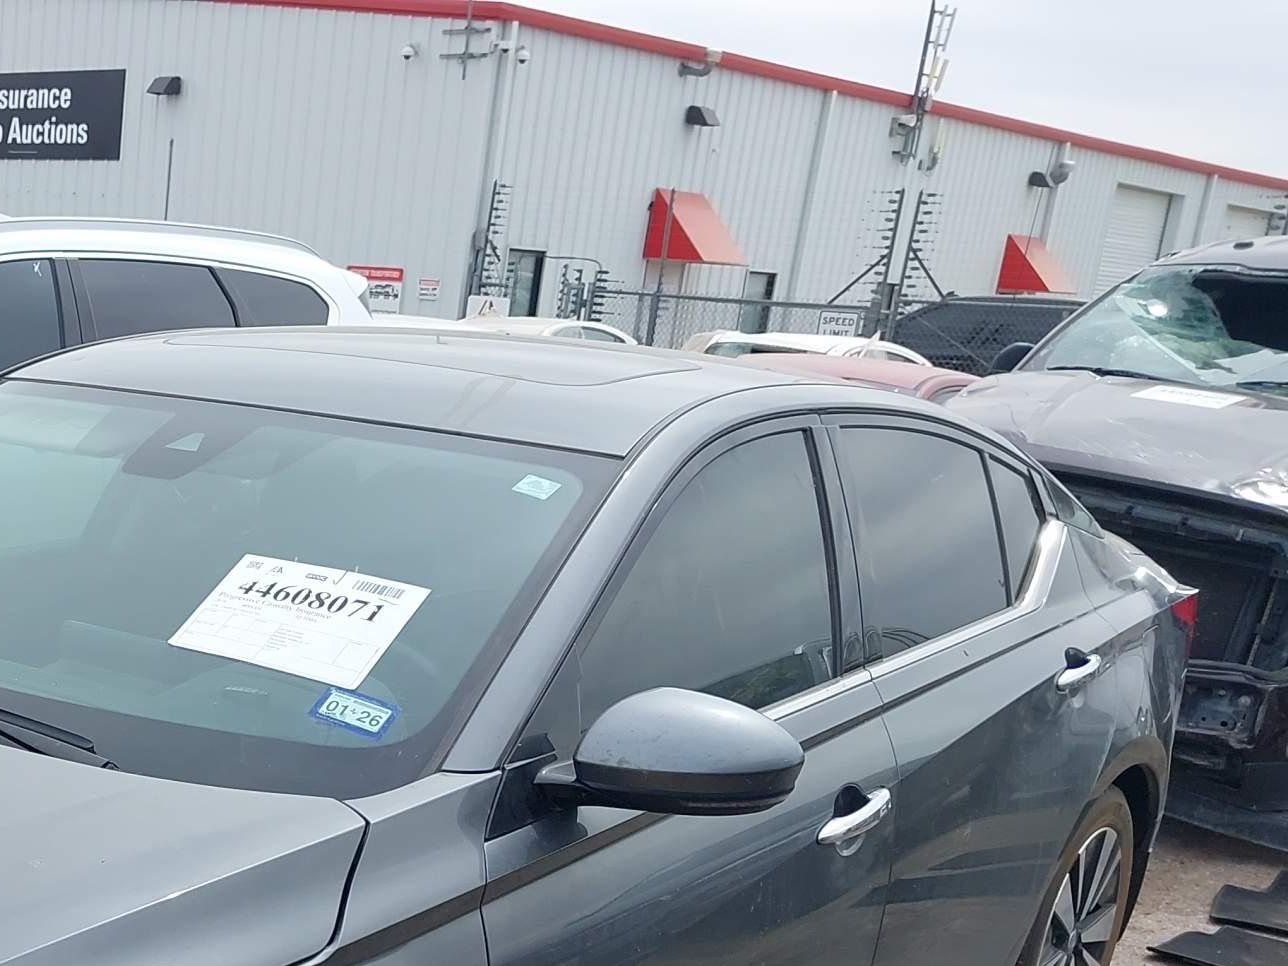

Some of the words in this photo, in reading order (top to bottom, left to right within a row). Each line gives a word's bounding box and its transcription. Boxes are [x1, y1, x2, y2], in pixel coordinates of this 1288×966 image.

[7, 115, 89, 145] Auctions
[822, 316, 855, 326] SPEED
[238, 581, 385, 622] 44608071
